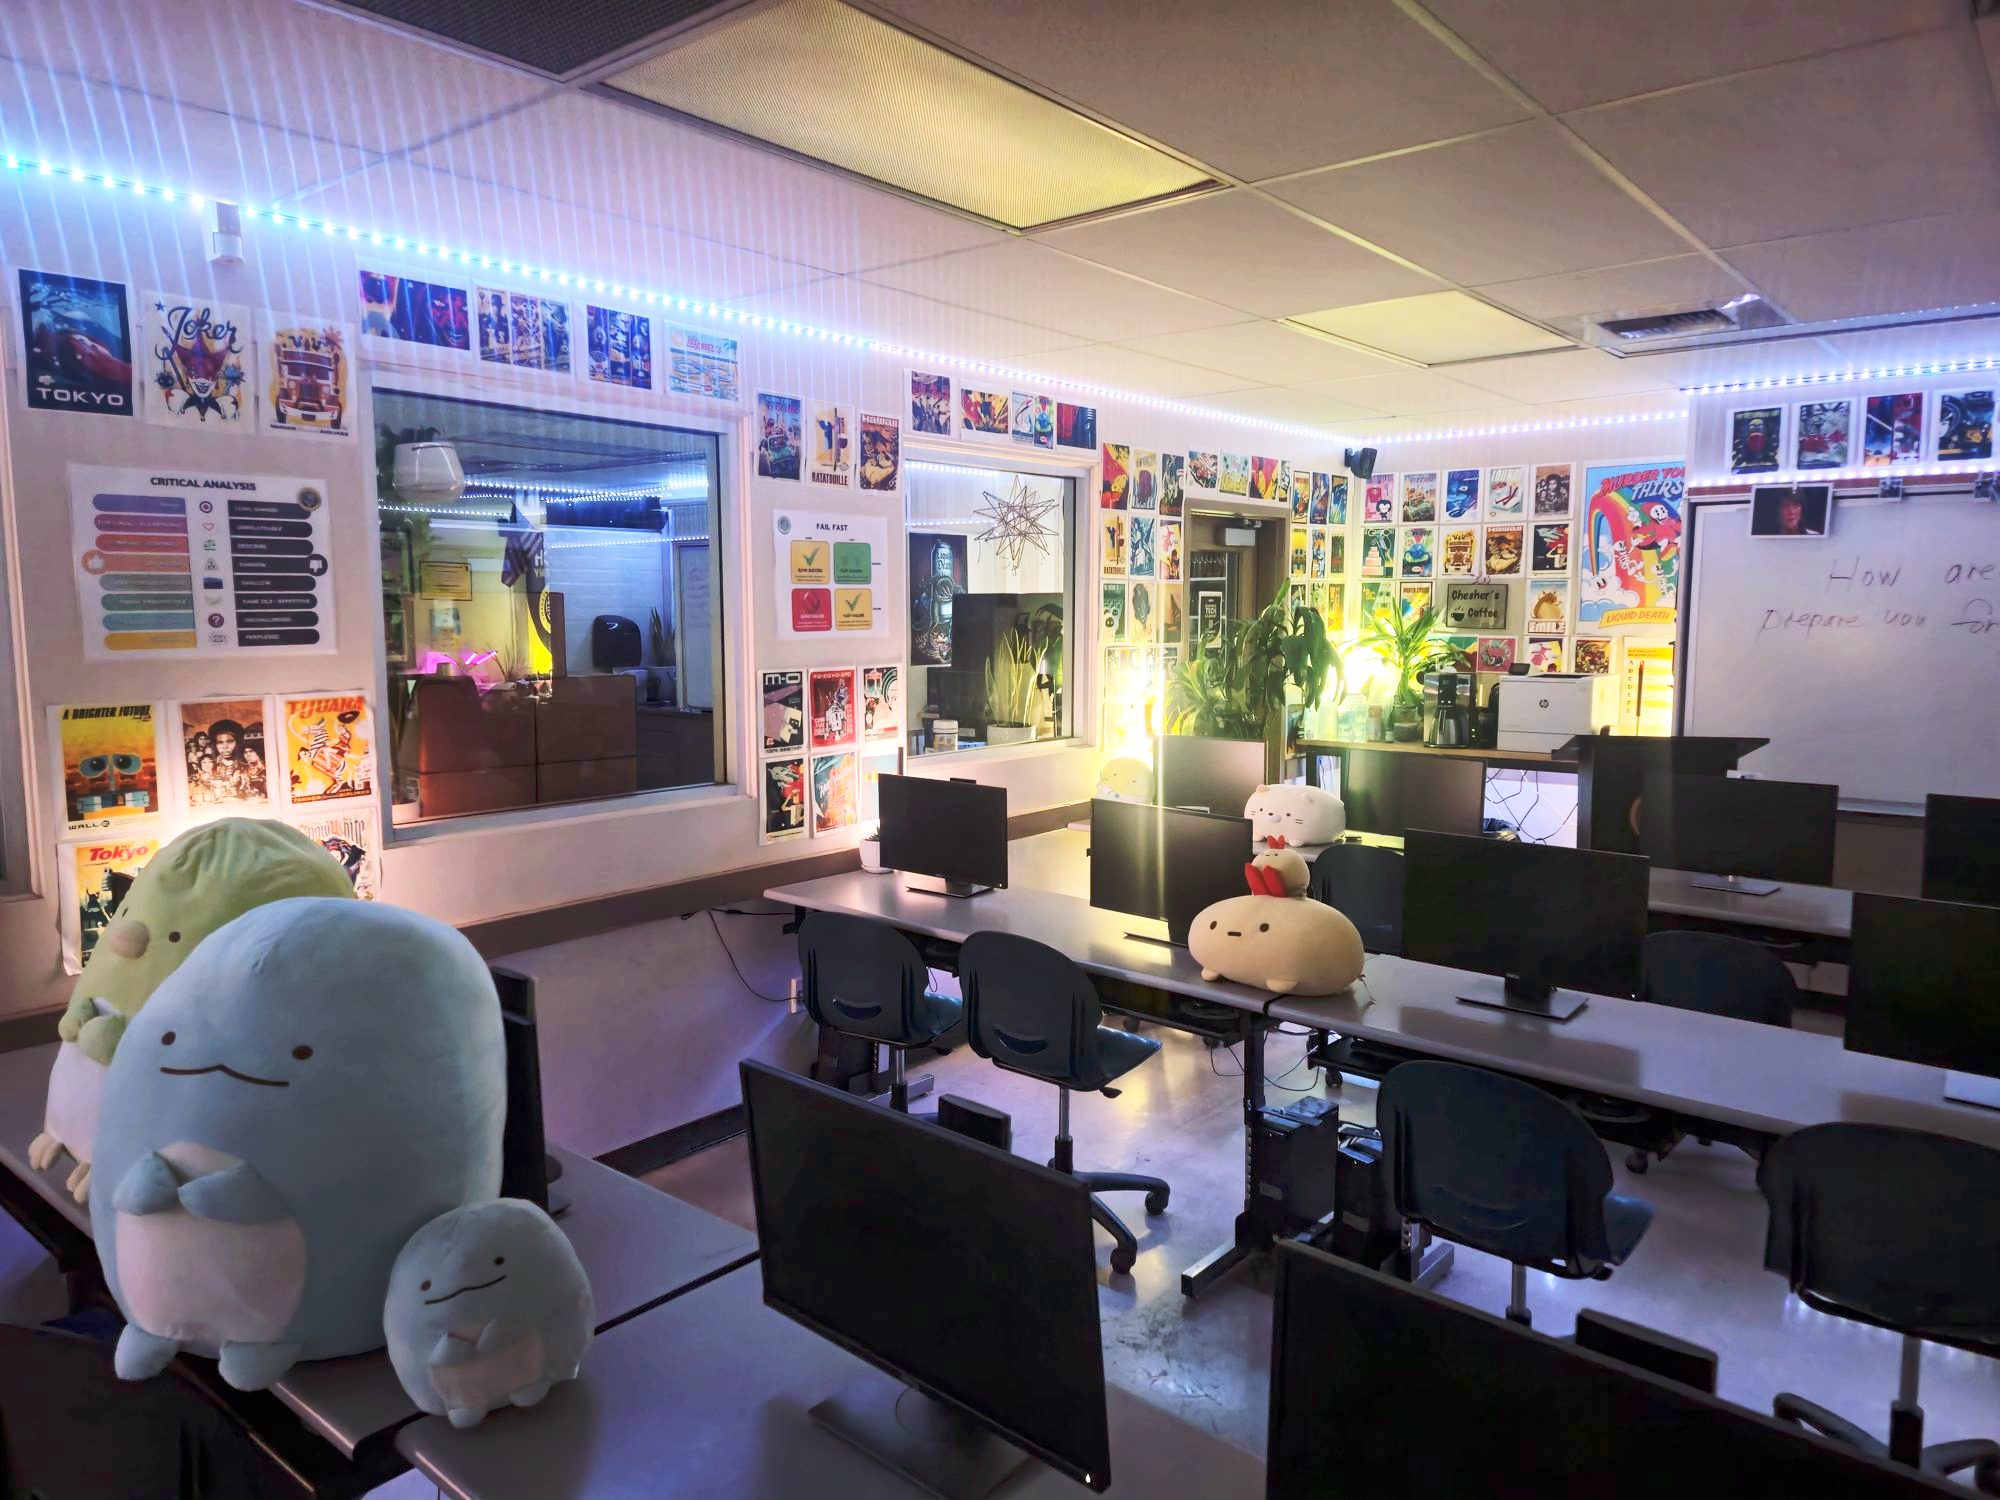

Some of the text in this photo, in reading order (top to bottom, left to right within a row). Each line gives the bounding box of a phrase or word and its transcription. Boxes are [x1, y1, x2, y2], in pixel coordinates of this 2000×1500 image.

[155, 306, 243, 360] Joker
[36, 386, 124, 407] TOKYO
[150, 477, 256, 491] CRITICAL ANALYSIS
[811, 471, 848, 486] RATATOUILLE
[1600, 468, 1660, 497] MURDER
[816, 523, 848, 532] FAIL FAST
[1825, 554, 1997, 592] How are
[1451, 589, 1500, 600] Chesher's
[1467, 607, 1499, 618] Coffee
[1606, 610, 1671, 623] LIQUID DEATH
[1529, 621, 1565, 632] EMILE
[1755, 608, 1866, 647] prepare
[62, 709, 69, 720] A
[72, 707, 117, 720] BRIGHTER
[119, 704, 152, 717] FUTURE
[89, 846, 149, 862] Tokyo
